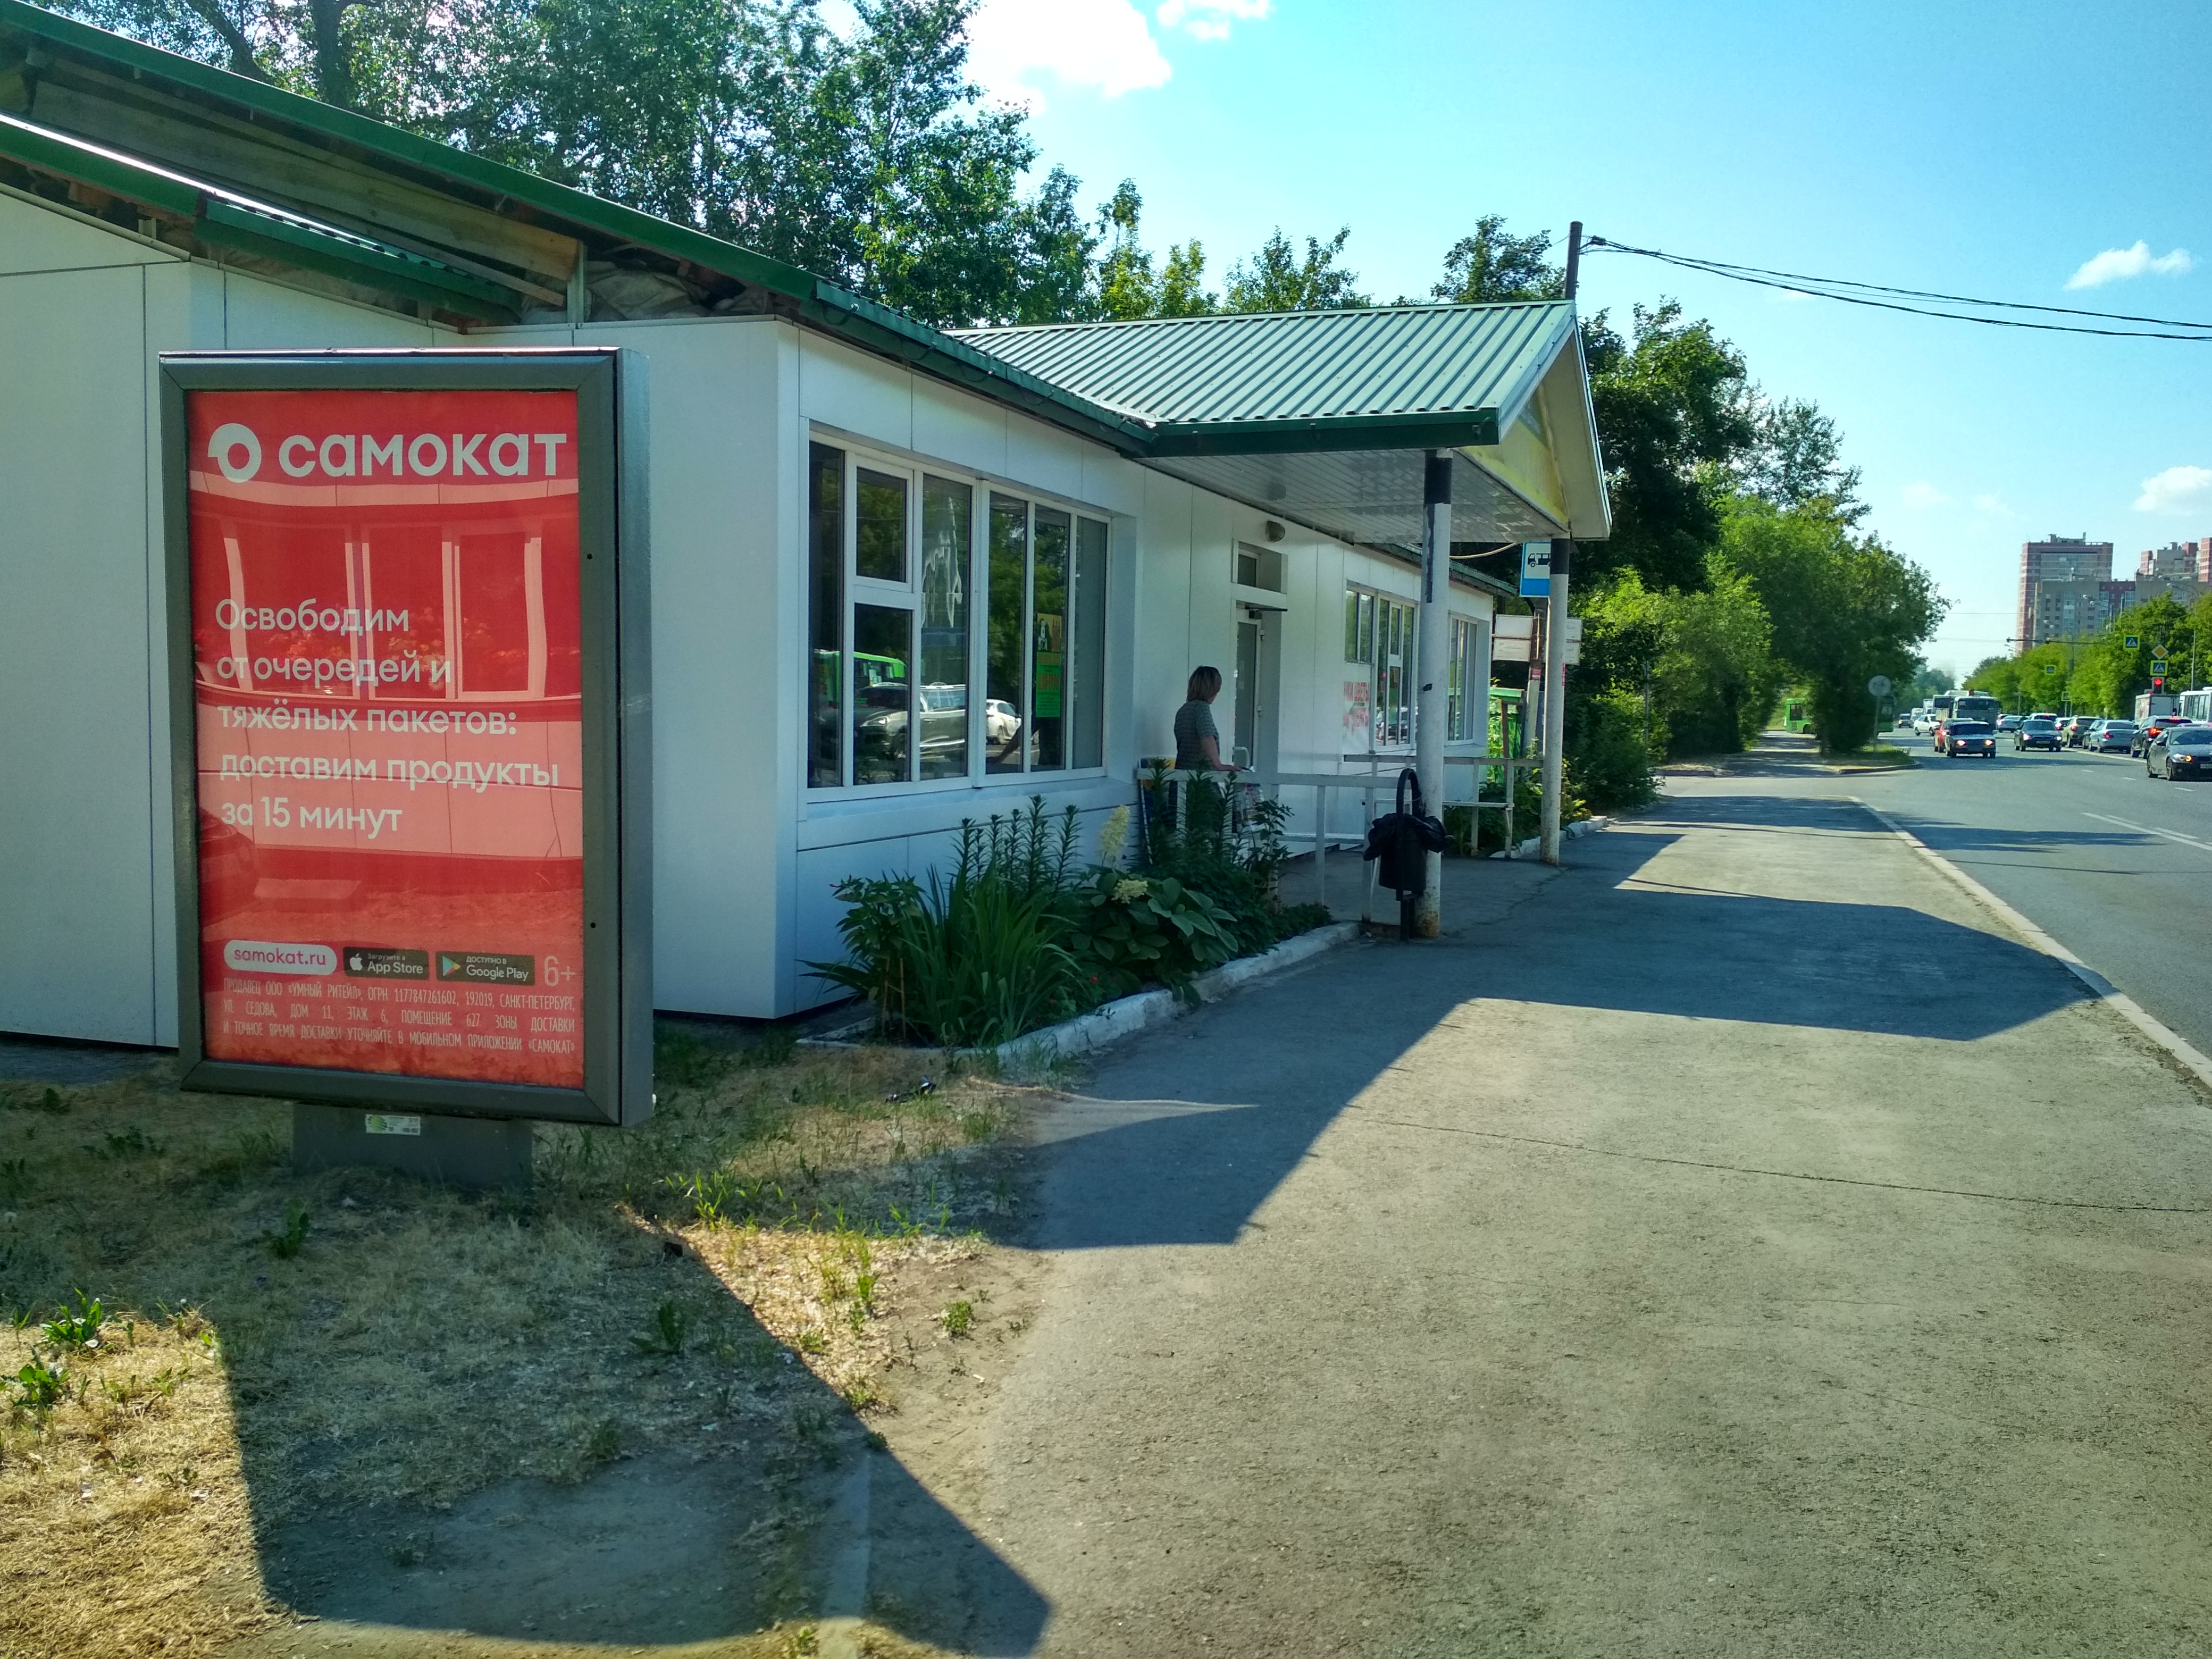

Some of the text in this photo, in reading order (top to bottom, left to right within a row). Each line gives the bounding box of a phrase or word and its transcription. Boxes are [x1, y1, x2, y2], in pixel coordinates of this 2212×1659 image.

[279, 432, 567, 477] самокат
[216, 599, 409, 636] Освободим
[217, 650, 451, 688] от очередей и
[218, 698, 516, 735] тяжёлых пакетов:
[220, 753, 559, 792] доставим продукты
[221, 797, 403, 839] за 15 минут
[234, 948, 326, 966] samokat.ru
[367, 961, 423, 974] App Store
[466, 965, 529, 982] Google Play
[544, 956, 576, 986] 6+
[224, 978, 261, 996] ПРОДАВЕЦ
[266, 982, 282, 995] ООО
[368, 987, 388, 1001] ОГРН
[394, 988, 459, 1006] 1177847261602,
[465, 991, 495, 1009] 192019,
[500, 993, 575, 1012] САНКТ-ПЕТЕРБУРГ,
[246, 1001, 278, 1018] СЕДОВА,
[290, 1003, 308, 1019] ДОМ
[322, 1005, 334, 1020] 11,
[347, 1006, 368, 1021] ЭТАЖ
[401, 1010, 452, 1026] ПОМЕЩЕНИЕ
[495, 1015, 517, 1030] ЗОНЫ
[531, 1017, 575, 1033] ДОСТАВКИ
[223, 1020, 575, 1054] И ТОЧНОЕ ВРЕМЯ ДОСТАВКИ УТОЧНЯЙТЕ В МОБИЛЬНОМ ПРИЛОЖЕНИИ «САМОКАТ»
